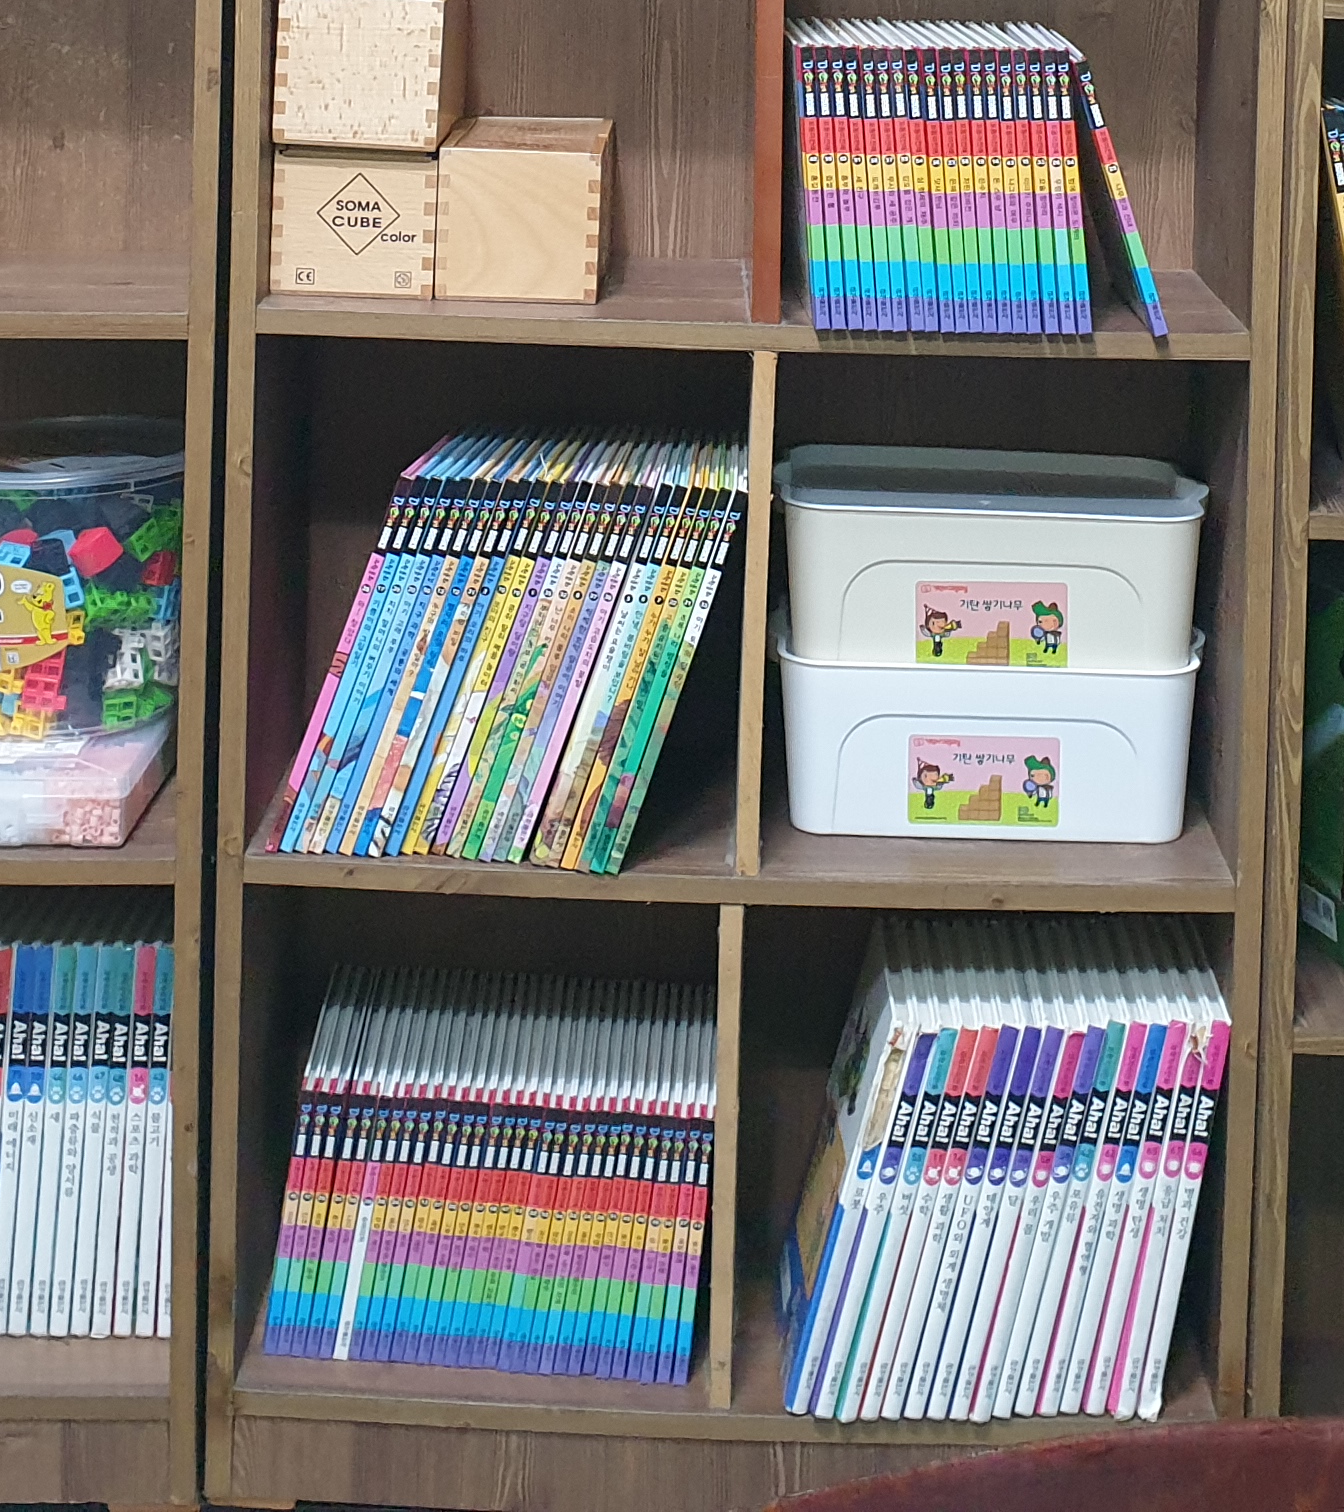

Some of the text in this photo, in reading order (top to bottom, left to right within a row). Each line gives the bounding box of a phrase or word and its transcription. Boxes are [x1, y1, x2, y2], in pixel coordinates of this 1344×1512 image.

[331, 215, 382, 228] CUBE
[336, 199, 382, 212] SOMA
[380, 231, 417, 243] color
[298, 271, 313, 282] CE
[960, 599, 1023, 612] 기탄 쌓기나무
[953, 752, 1016, 766] 기탄 쌓기나무
[30, 1021, 46, 1061] Aha!
[72, 1022, 89, 1061] Aha!
[153, 1023, 168, 1062] Aha!
[891, 1101, 913, 1143] Aha!
[915, 1100, 937, 1142] Aha!
[935, 1101, 957, 1144] Aha!
[956, 1101, 978, 1143] Aha!
[977, 1101, 999, 1143] Aha!
[1000, 1101, 1022, 1144] Aha!
[1021, 1102, 1043, 1145] Aha!
[1043, 1104, 1065, 1145] Aha!
[1063, 1099, 1085, 1141] Aha!
[1084, 1096, 1106, 1138] Aha!
[1108, 1096, 1129, 1139] Aha!
[1126, 1099, 1148, 1141] Aha!
[1149, 1094, 1170, 1137] Aha!
[1173, 1093, 1193, 1135] Aha!
[1194, 1096, 1215, 1138] Aha!
